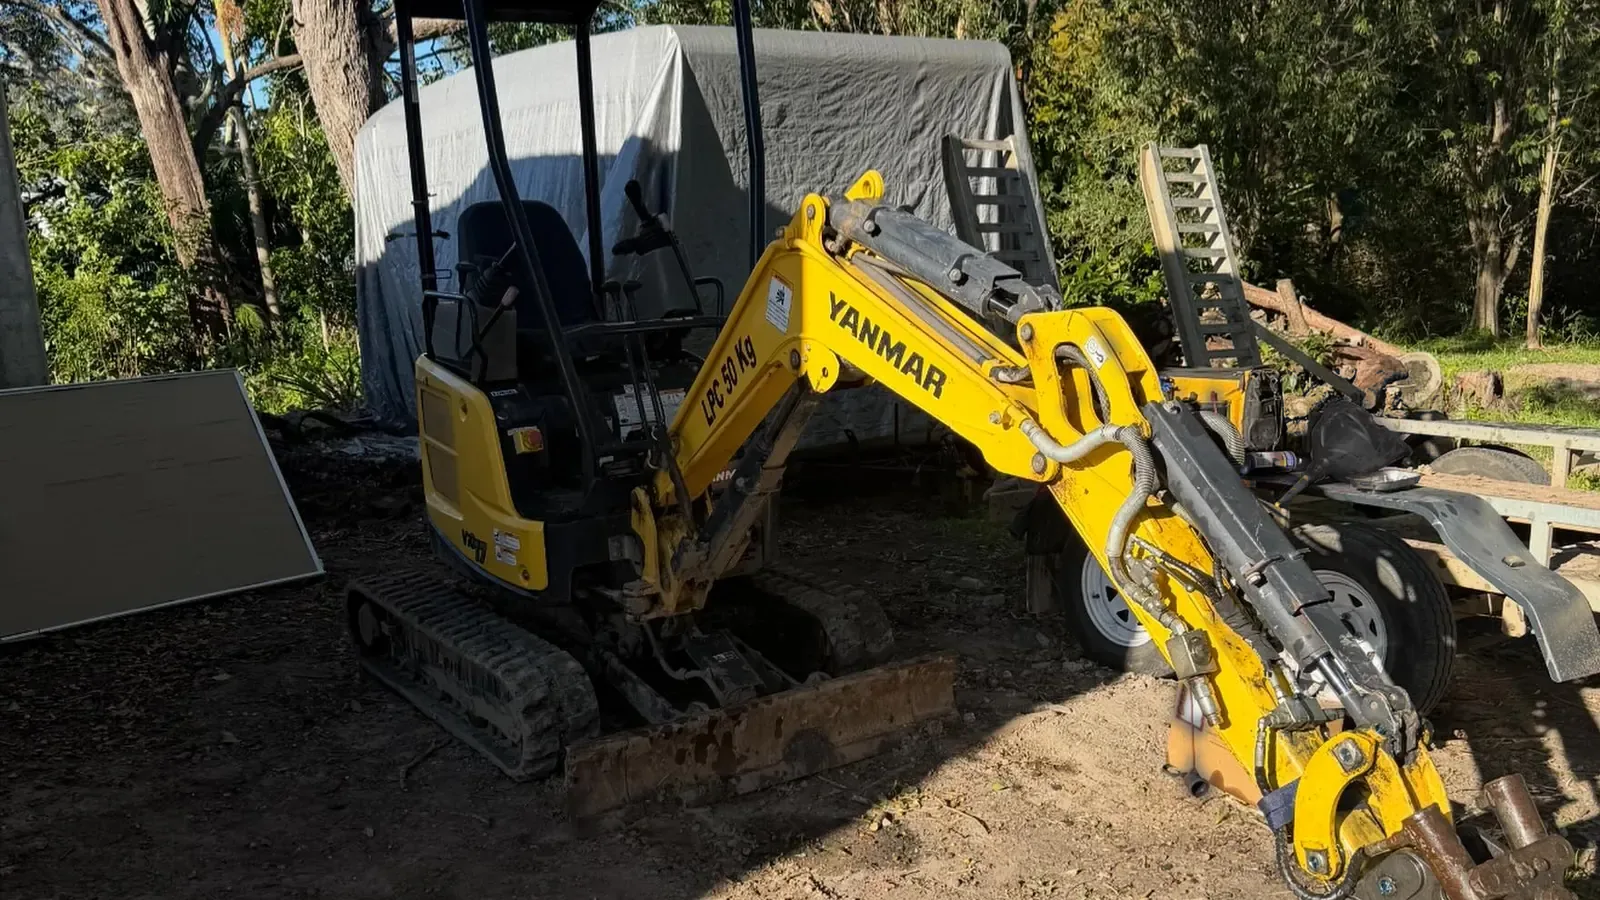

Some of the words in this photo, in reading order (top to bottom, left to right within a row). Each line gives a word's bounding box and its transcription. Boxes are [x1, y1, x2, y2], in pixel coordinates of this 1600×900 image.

[701, 379, 724, 427] LPC
[721, 356, 738, 395] 50
[734, 335, 757, 374] Kg
[829, 291, 947, 399] YANMAR
